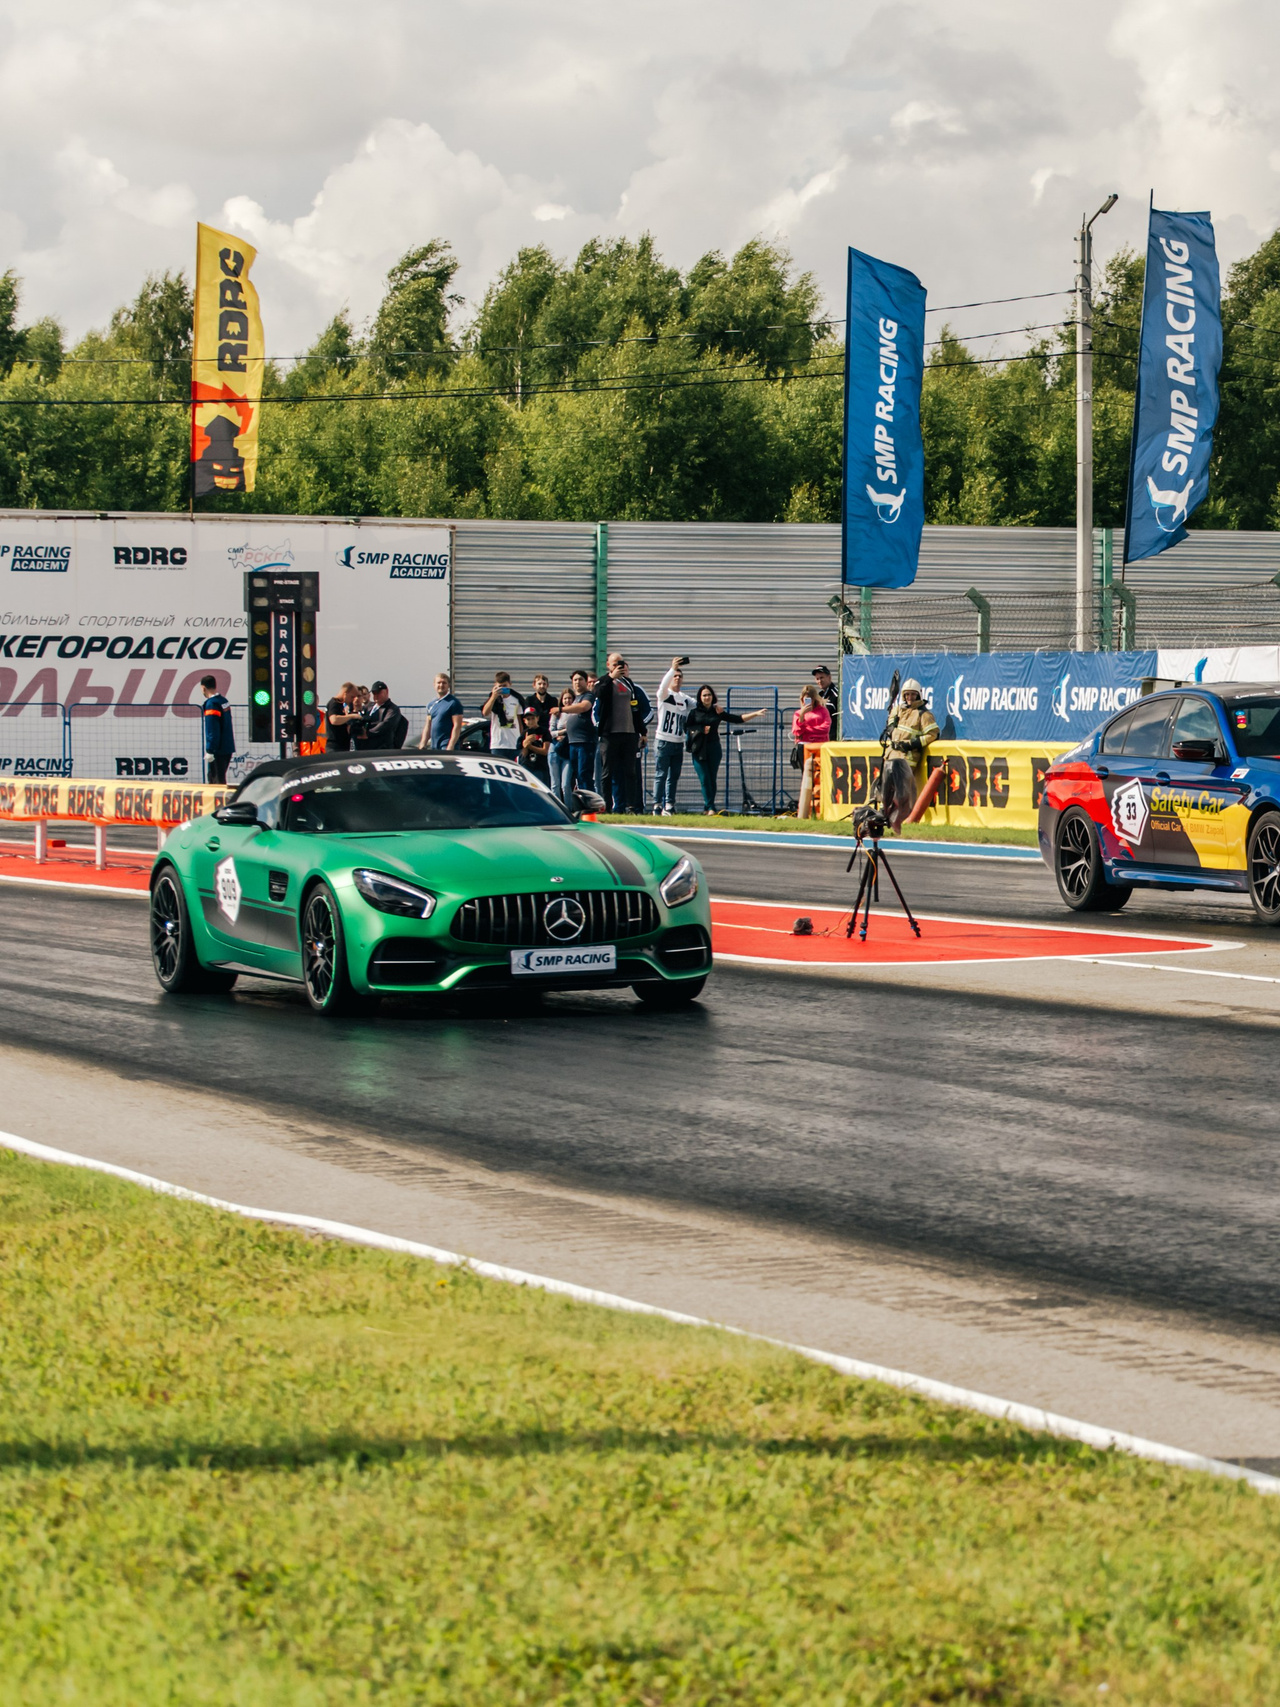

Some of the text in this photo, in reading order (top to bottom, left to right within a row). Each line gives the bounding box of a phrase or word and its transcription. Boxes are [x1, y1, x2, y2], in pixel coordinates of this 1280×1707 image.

[217, 247, 250, 373] RDRC
[1159, 237, 1199, 476] SMP RACING
[874, 317, 899, 485] SMP RACING
[13, 545, 72, 559] RACING
[113, 546, 188, 566] RDRC
[357, 552, 449, 566] SMP RACING
[13, 560, 68, 571] ACADEMY
[392, 567, 445, 578] ACADEMY
[78, 614, 175, 628] спортивный
[279, 615, 290, 738] DRAGTIMES
[864, 687, 889, 710] SMP
[962, 687, 1038, 711] SMP RACING
[1070, 687, 1099, 711] SMP
[14, 758, 74, 771] RACING
[115, 757, 188, 775] RDRC
[371, 760, 443, 771] RDRC
[478, 761, 528, 782] 909
[301, 769, 341, 784] RACING
[24, 783, 60, 816] RDRC
[68, 785, 106, 818] RDRC
[115, 787, 154, 822] RDRC
[161, 789, 204, 824] RDRC
[1150, 786, 1225, 818] Safety Car
[1125, 802, 1137, 820] 33
[1150, 820, 1171, 831] Official
[1171, 821, 1182, 832] Car
[221, 878, 237, 901] 909
[536, 953, 611, 967] SMP RACING
